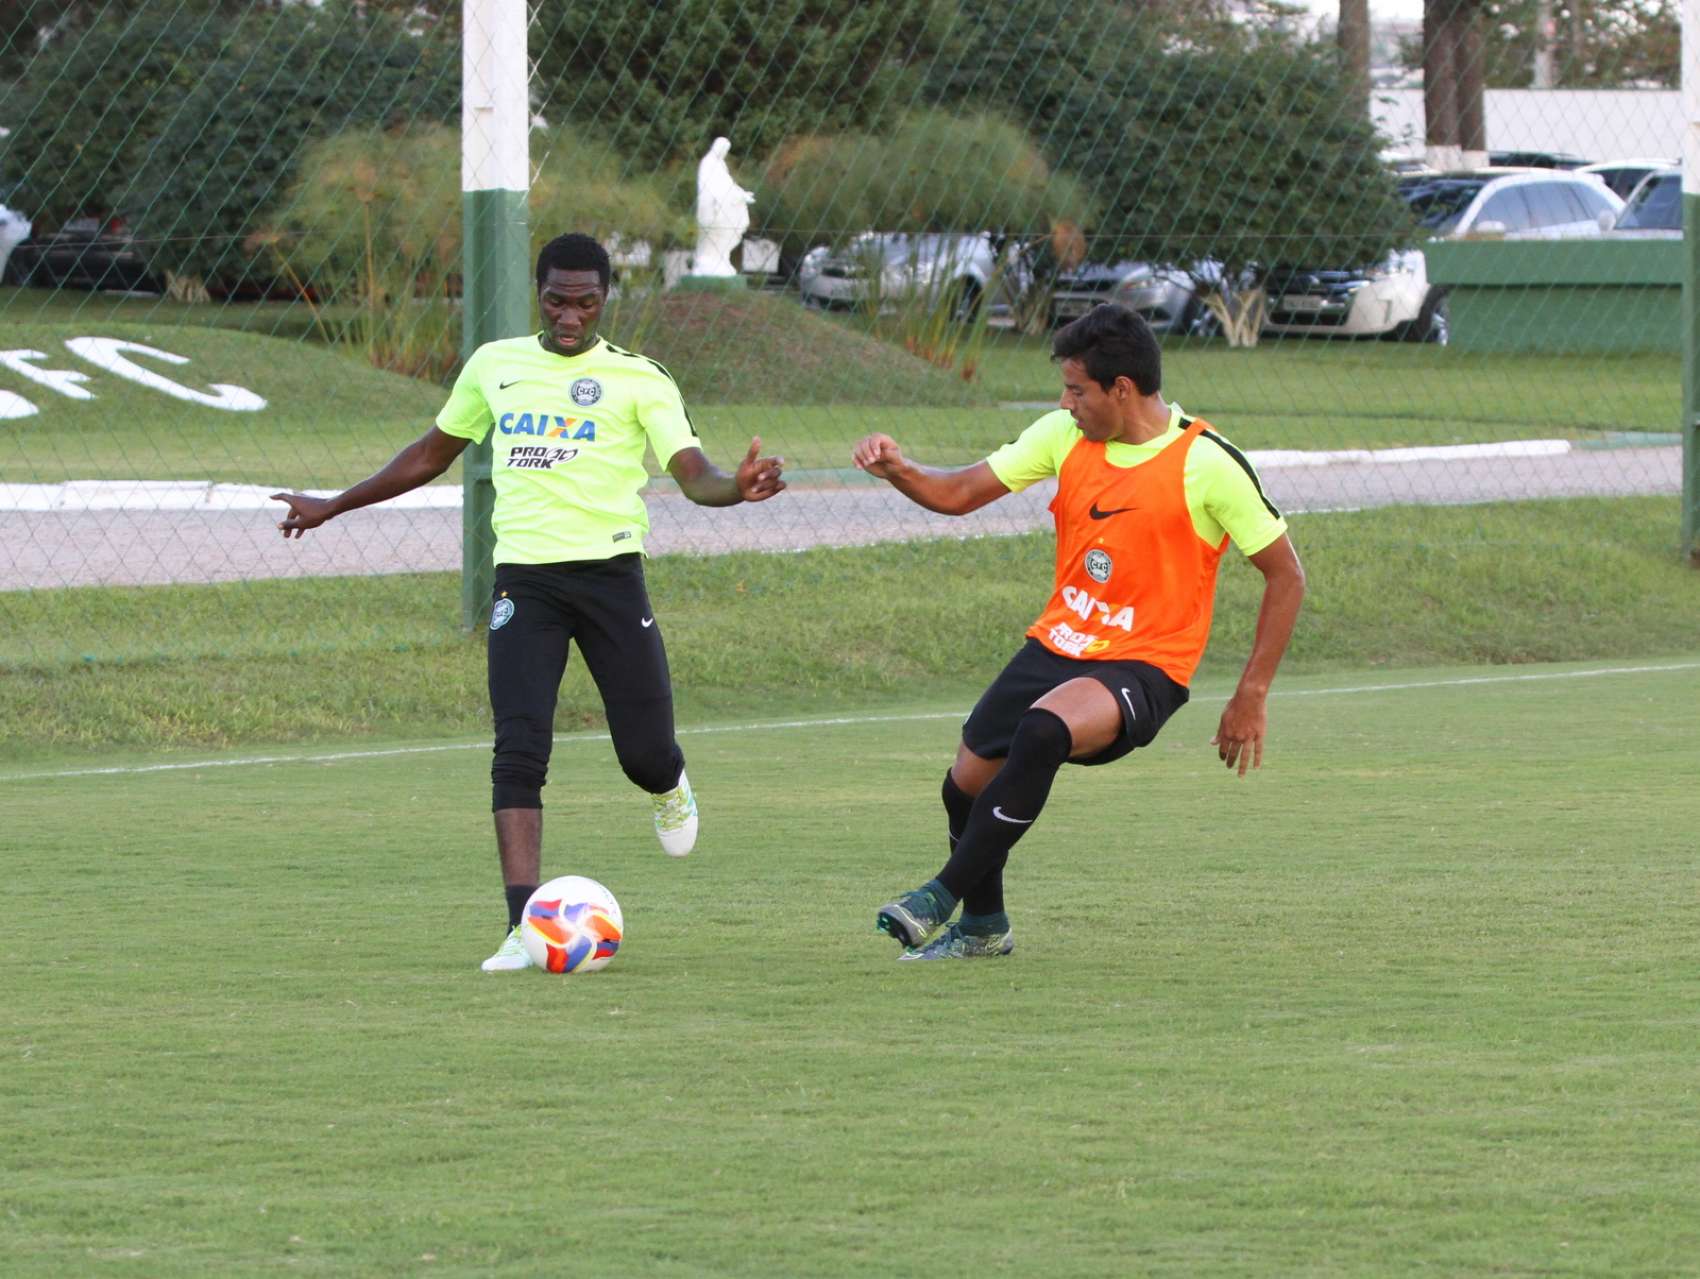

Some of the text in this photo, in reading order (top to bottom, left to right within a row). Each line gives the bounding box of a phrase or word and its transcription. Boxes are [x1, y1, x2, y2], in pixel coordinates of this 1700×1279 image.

[499, 412, 596, 442] CAIXA
[511, 446, 547, 457] PRO
[507, 458, 555, 469] TORK
[1062, 585, 1134, 632] CAIXA
